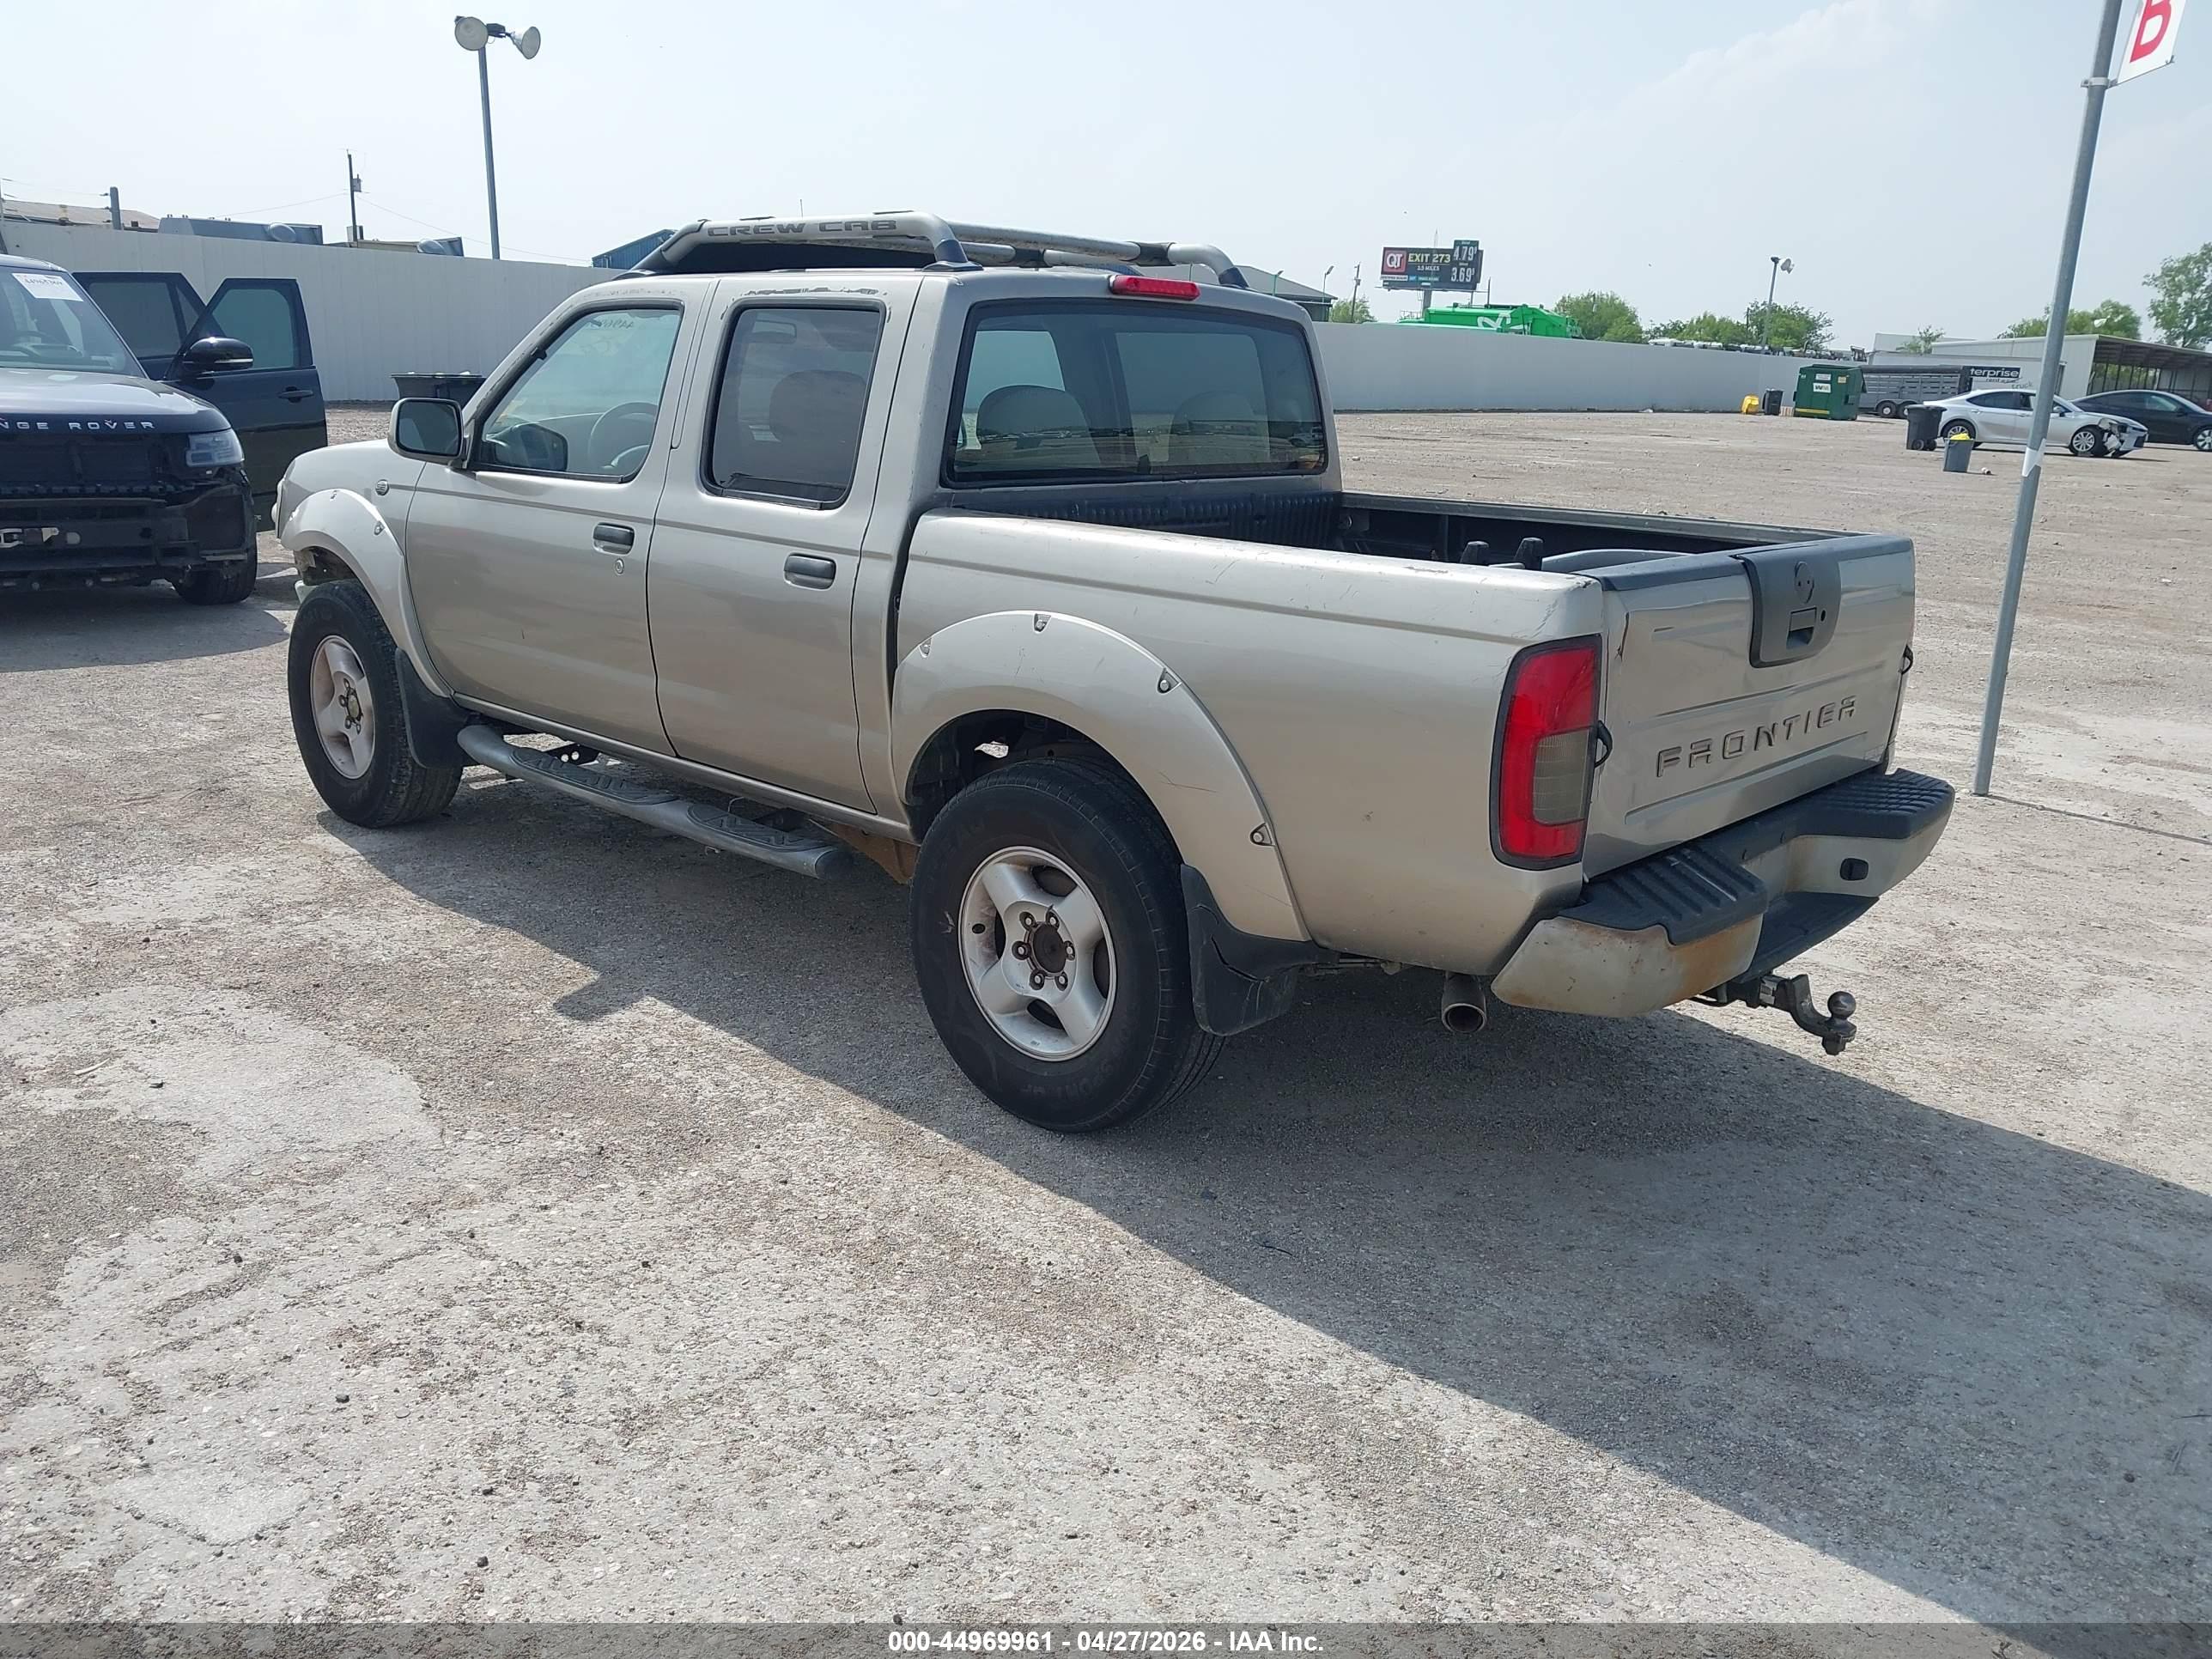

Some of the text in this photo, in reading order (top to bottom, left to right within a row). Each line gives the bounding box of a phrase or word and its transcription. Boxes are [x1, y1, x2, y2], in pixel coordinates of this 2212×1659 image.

[708, 220, 896, 237] CREW CAB
[1386, 252, 1403, 268] QT
[1408, 252, 1451, 264] EXIT 273
[69, 420, 155, 429] ROVER
[1656, 695, 1856, 777] FRONTIER
